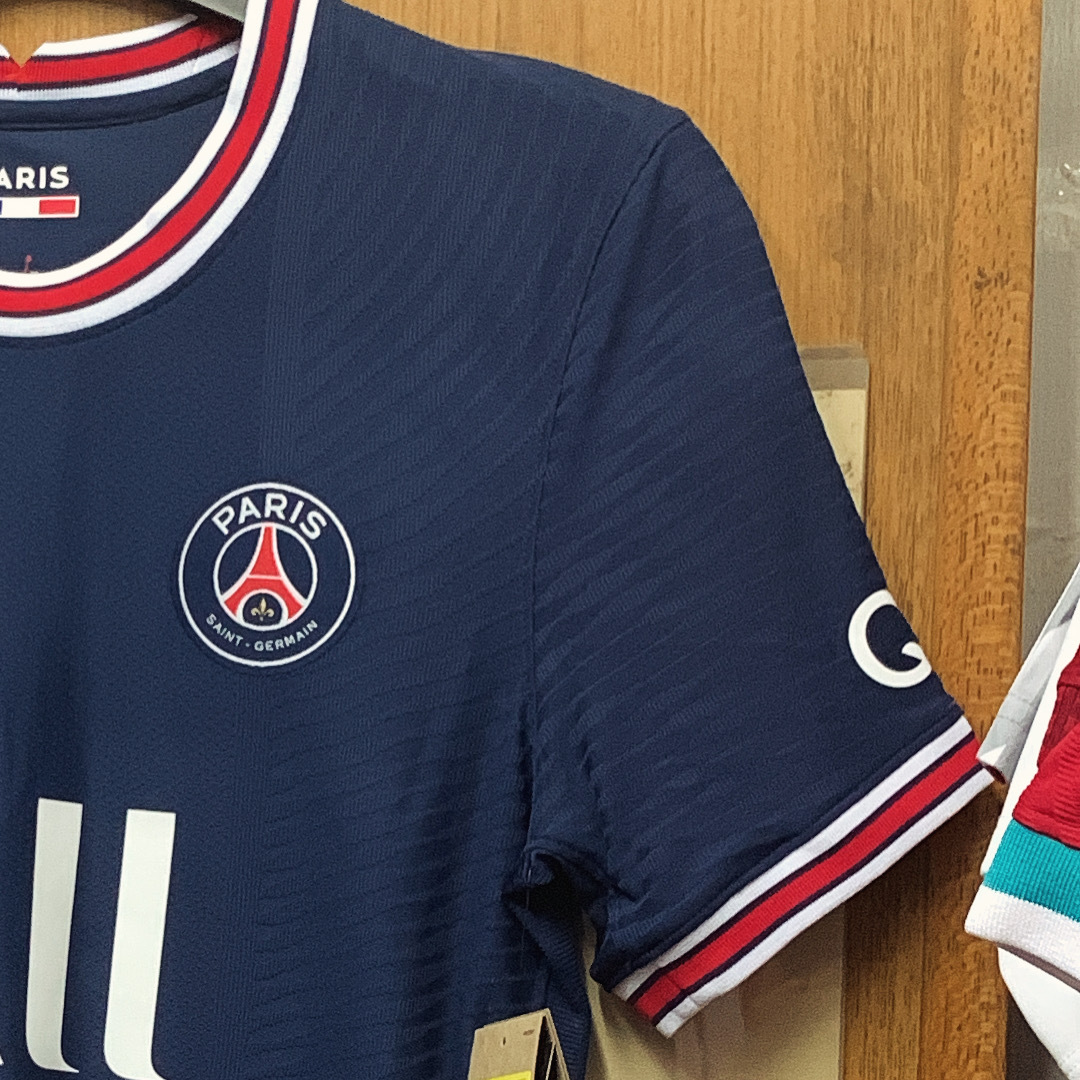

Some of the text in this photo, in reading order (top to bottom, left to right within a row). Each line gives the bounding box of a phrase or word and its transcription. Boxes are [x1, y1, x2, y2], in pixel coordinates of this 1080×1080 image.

[211, 493, 328, 541] PARIS
[206, 613, 318, 651] SAINT GERMAIN
